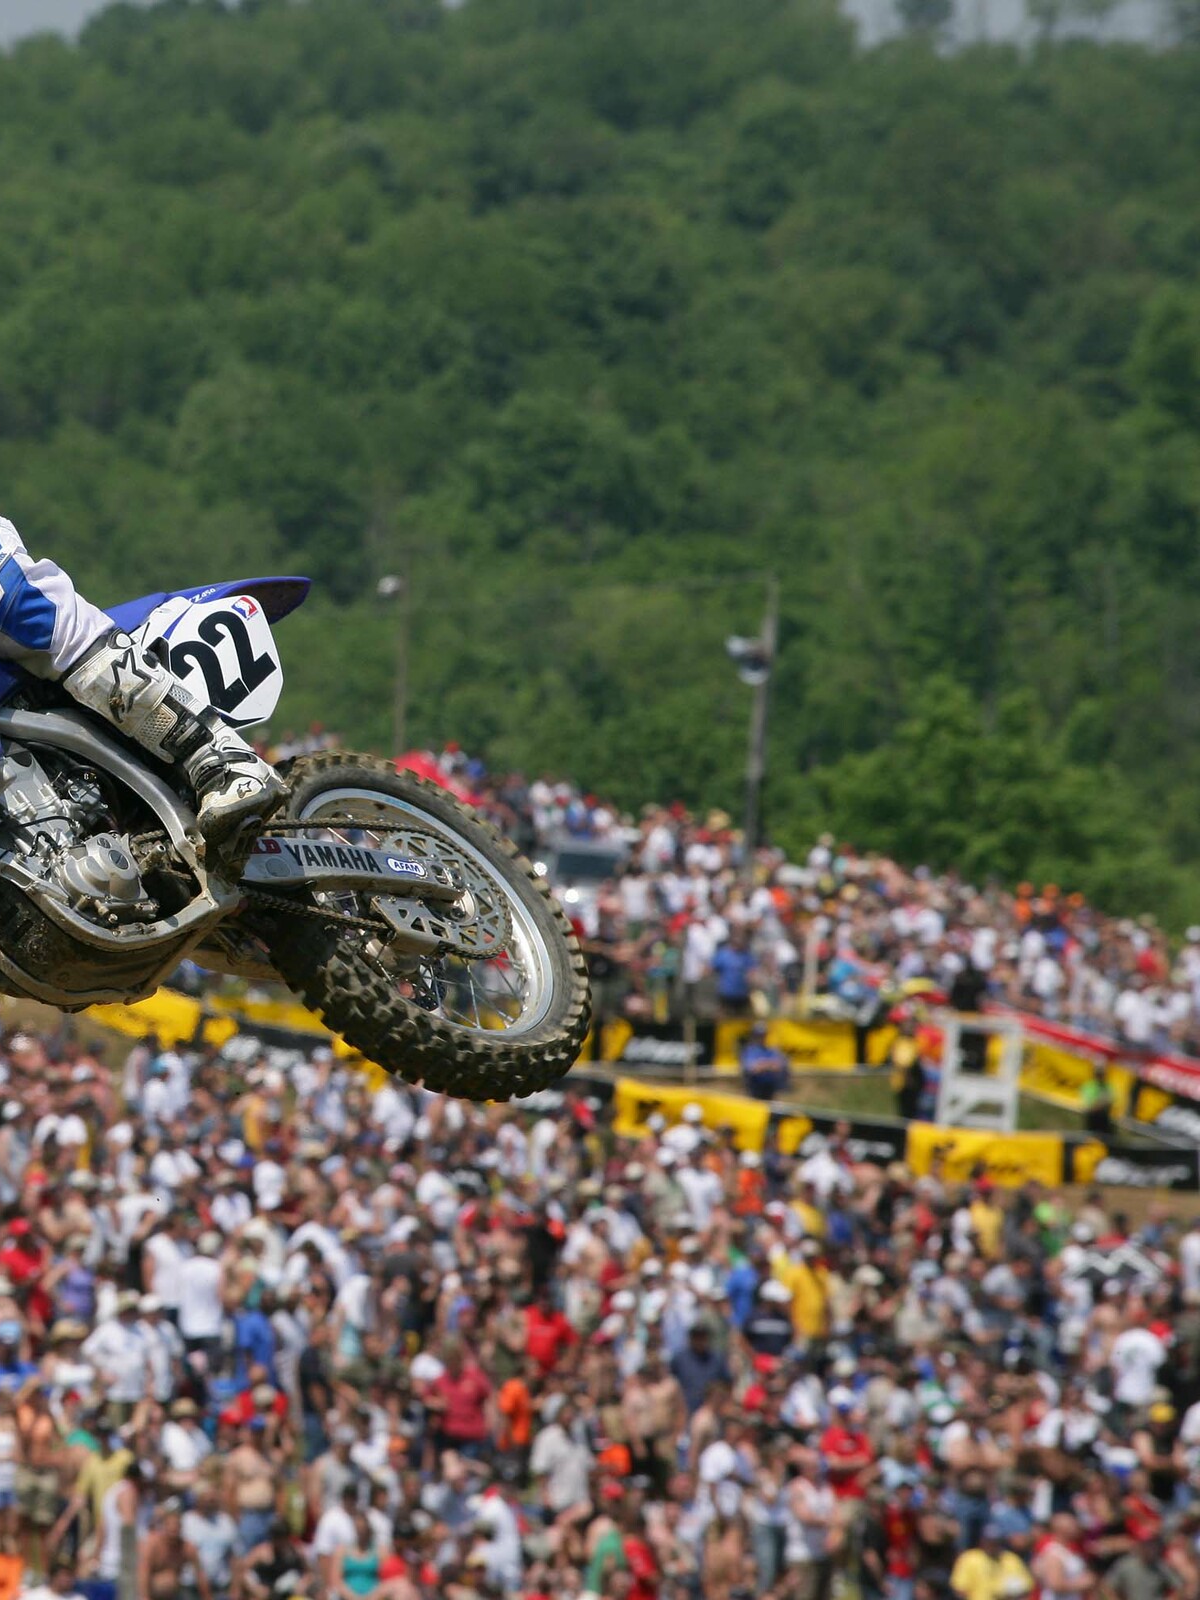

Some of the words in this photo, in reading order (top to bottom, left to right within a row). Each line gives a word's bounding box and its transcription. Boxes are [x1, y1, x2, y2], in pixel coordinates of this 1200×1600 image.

[170, 611, 277, 713] 22
[285, 844, 383, 874] YAMAHA
[394, 861, 421, 873] AFAM
